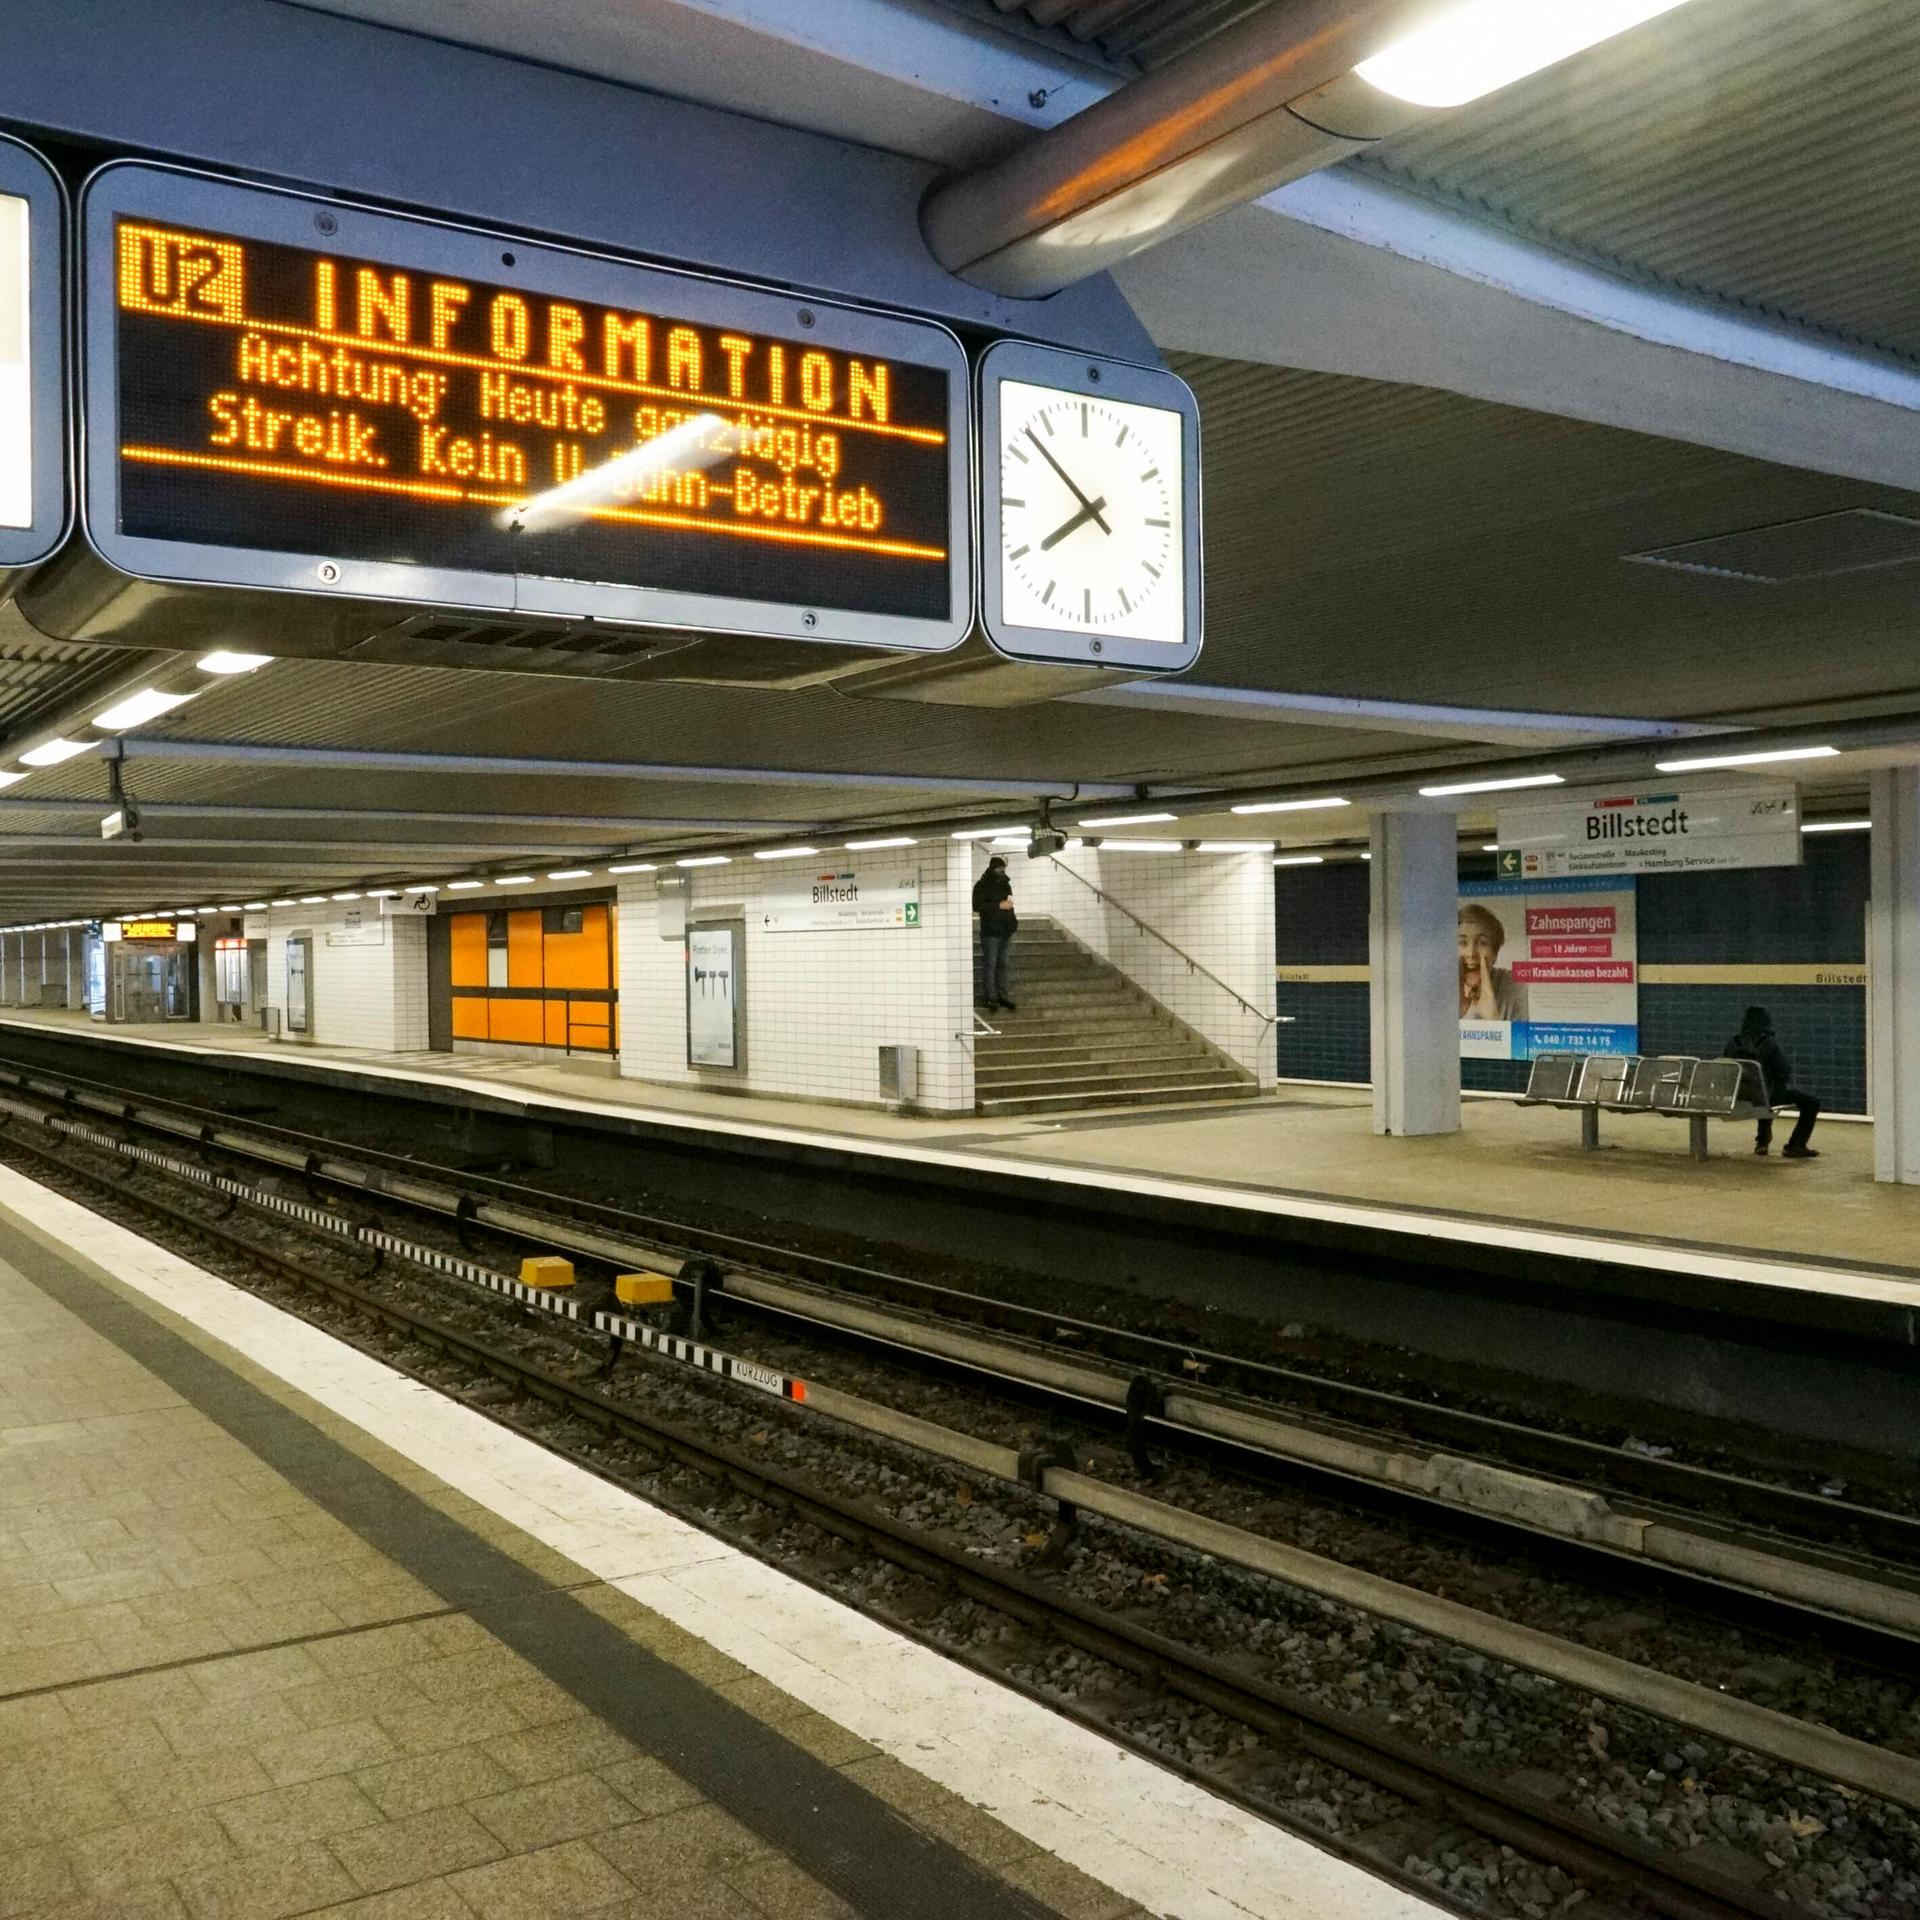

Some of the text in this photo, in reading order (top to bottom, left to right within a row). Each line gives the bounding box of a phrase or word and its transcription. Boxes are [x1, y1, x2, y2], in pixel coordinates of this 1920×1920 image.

[140, 238, 224, 315] U2
[314, 260, 890, 424] INFORMATION
[239, 331, 448, 420] Achtung:
[481, 371, 606, 434] Heute
[209, 393, 388, 466] Streik.
[420, 422, 527, 483] Kein
[1586, 809, 1689, 840] Billstedt
[1685, 856, 1716, 866] Service
[812, 884, 858, 903] Billstedt
[1530, 915, 1612, 933] Zahnspangen
[1553, 944, 1563, 953] 18
[1563, 943, 1587, 953] Jahren
[1532, 967, 1595, 979] Krankenkassen
[1596, 967, 1629, 978] bezahlt
[1568, 1035, 1584, 1046] 732
[1586, 1036, 1597, 1046] 14
[1599, 1036, 1612, 1047] 75
[737, 1363, 777, 1387] KURZZUG
